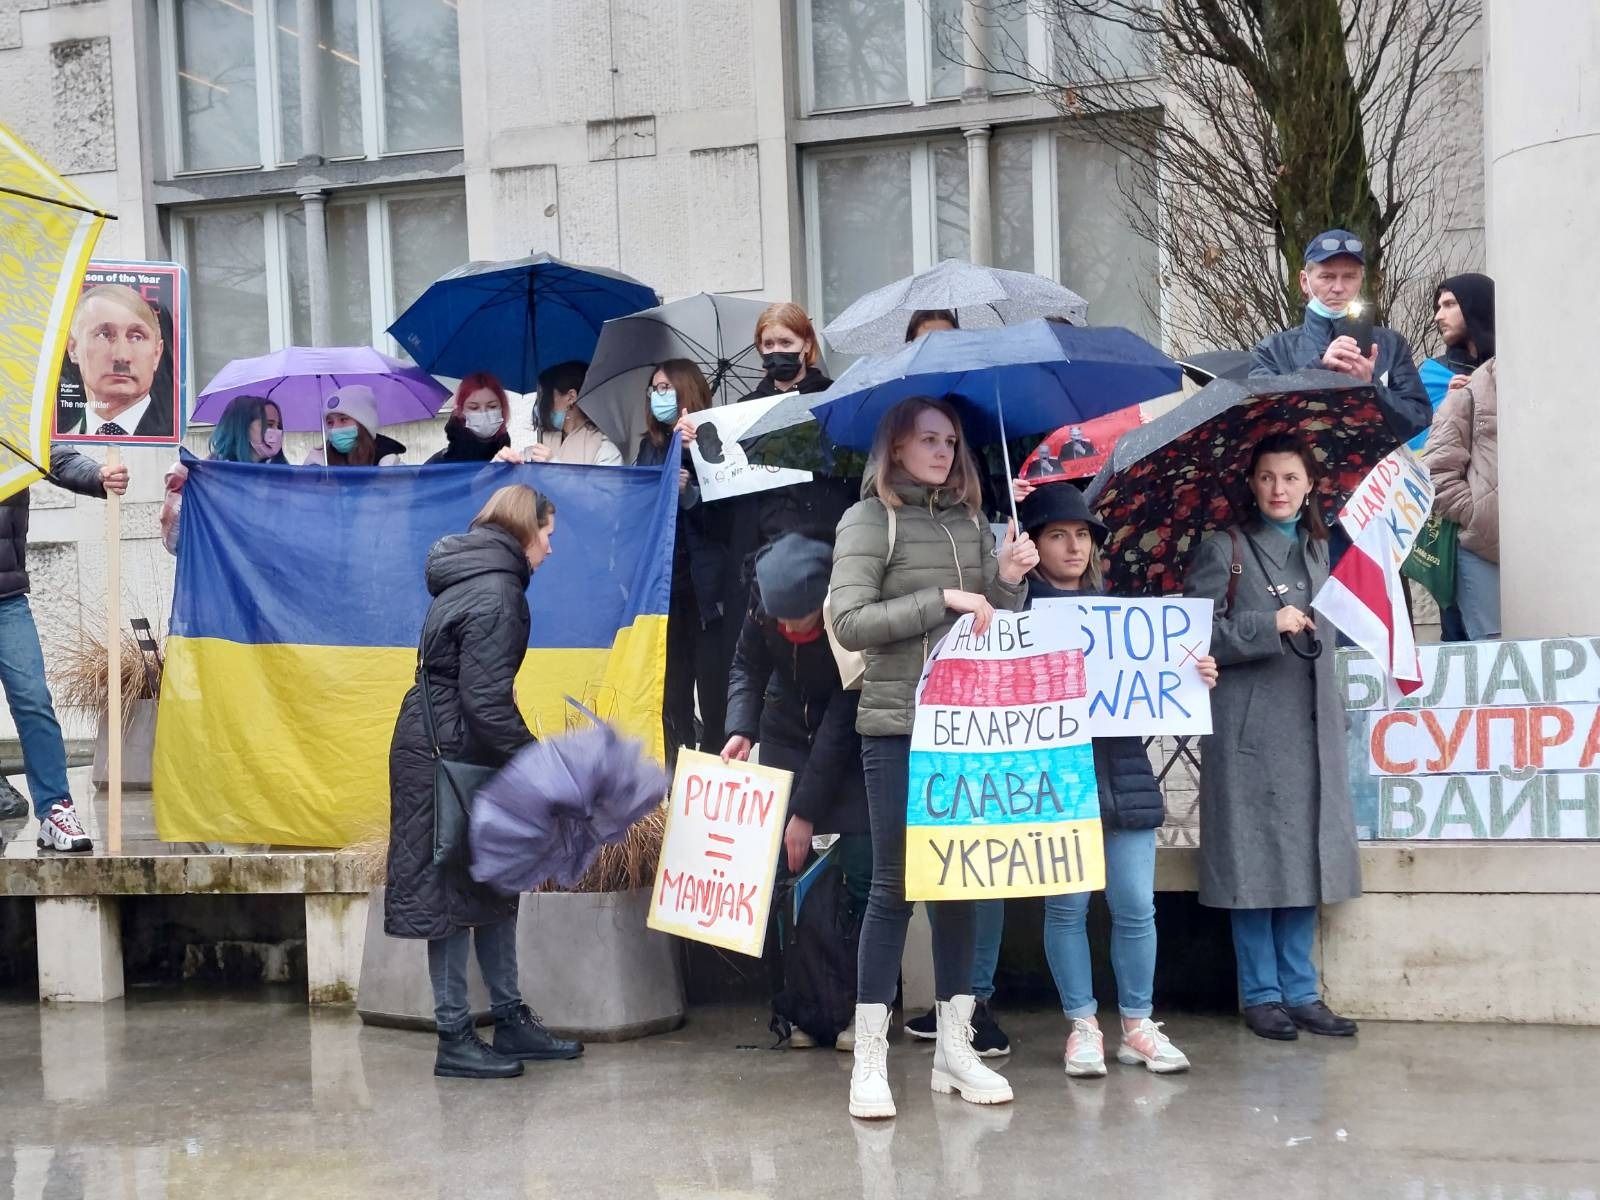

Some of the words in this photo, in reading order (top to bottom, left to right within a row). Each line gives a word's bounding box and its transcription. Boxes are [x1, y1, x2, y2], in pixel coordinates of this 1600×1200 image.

[106, 273, 118, 281] of
[119, 274, 136, 282] the
[138, 274, 160, 283] Year
[60, 400, 74, 408] The
[1088, 670, 1192, 719] WAR
[1336, 639, 1600, 711] БЛАР
[934, 705, 1080, 746] БЕЛАРУСЬ
[926, 771, 1065, 820] СЛАВА
[929, 828, 1084, 888] УКРАЇНІ
